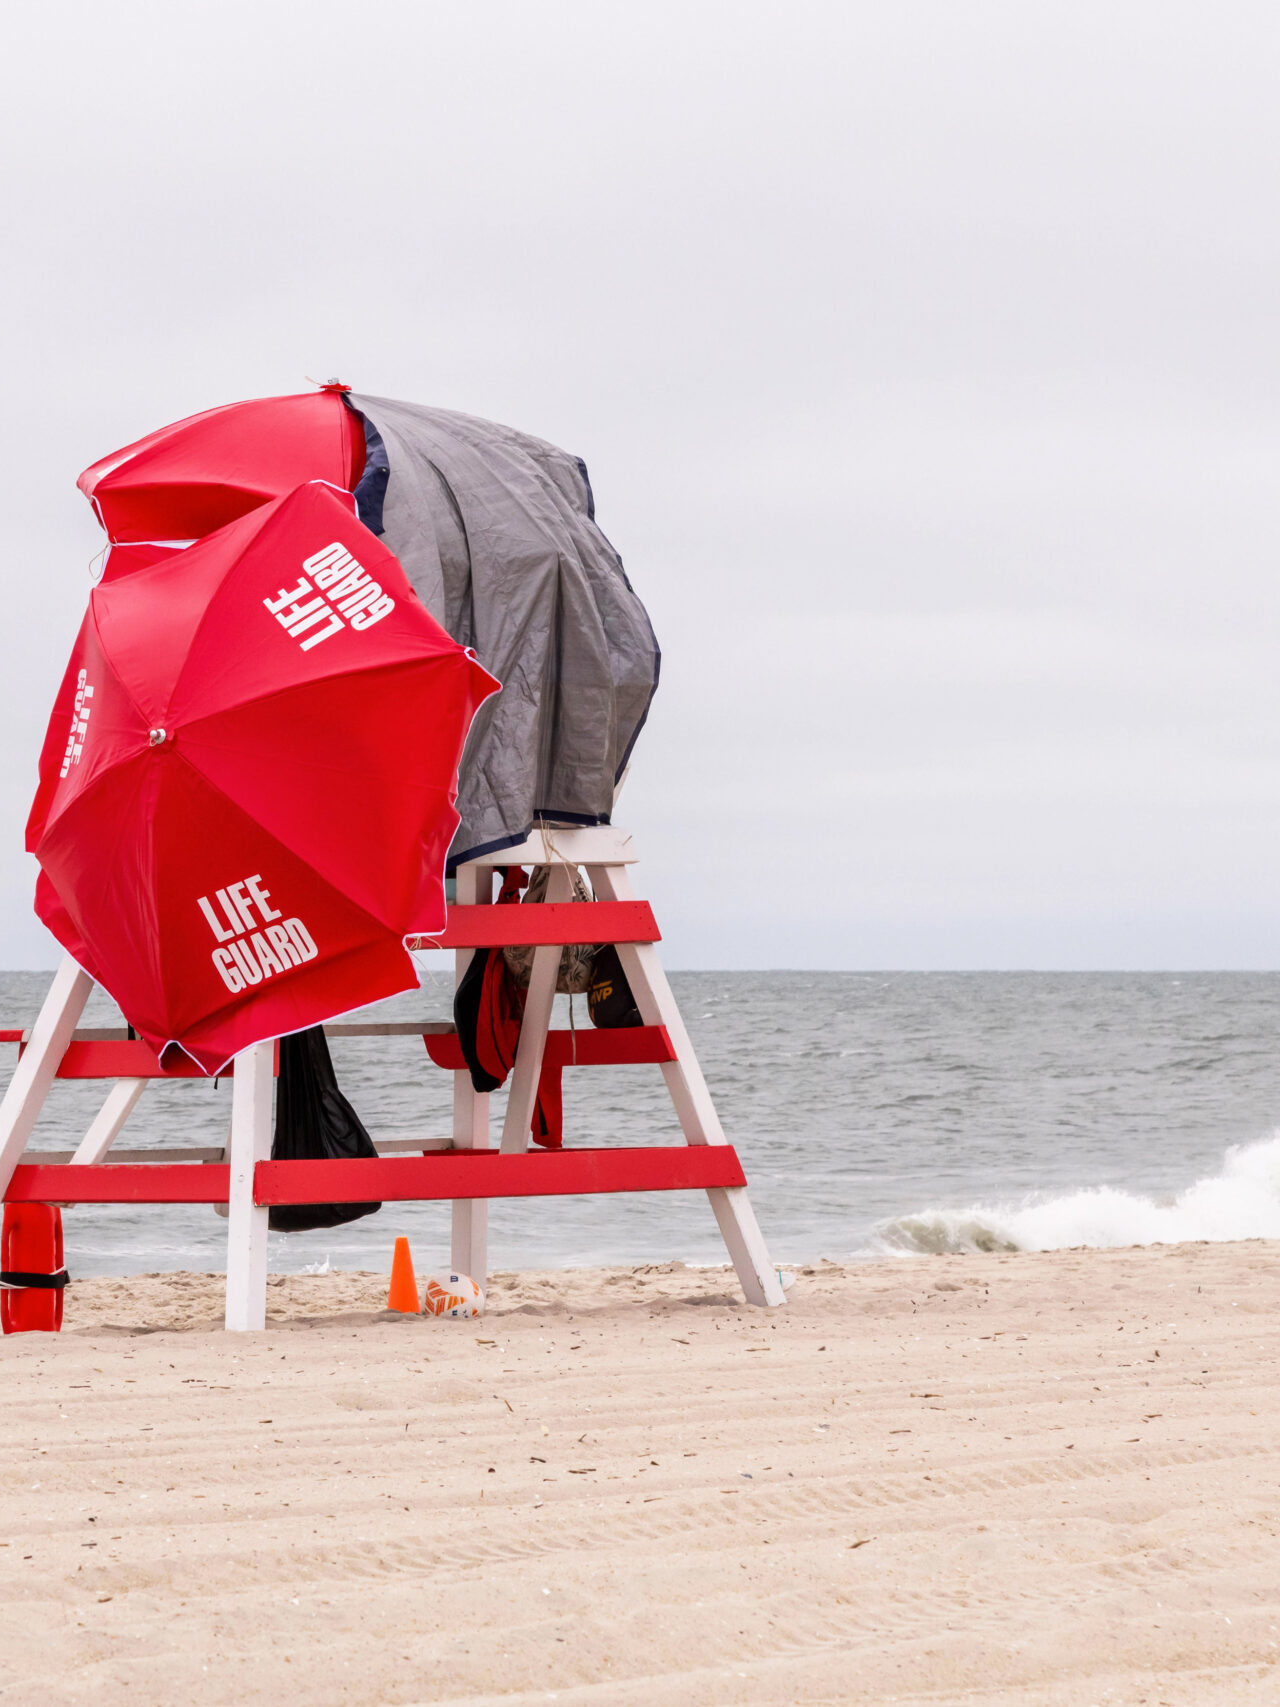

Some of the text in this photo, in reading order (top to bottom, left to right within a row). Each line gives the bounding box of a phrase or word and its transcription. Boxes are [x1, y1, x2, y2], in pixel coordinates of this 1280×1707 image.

[262, 576, 346, 652] LIFE
[302, 541, 396, 631] GUARD
[59, 668, 88, 779] GUARD
[70, 685, 95, 766] LIFE
[196, 873, 283, 943] LIFE
[211, 917, 319, 994] GUARD
